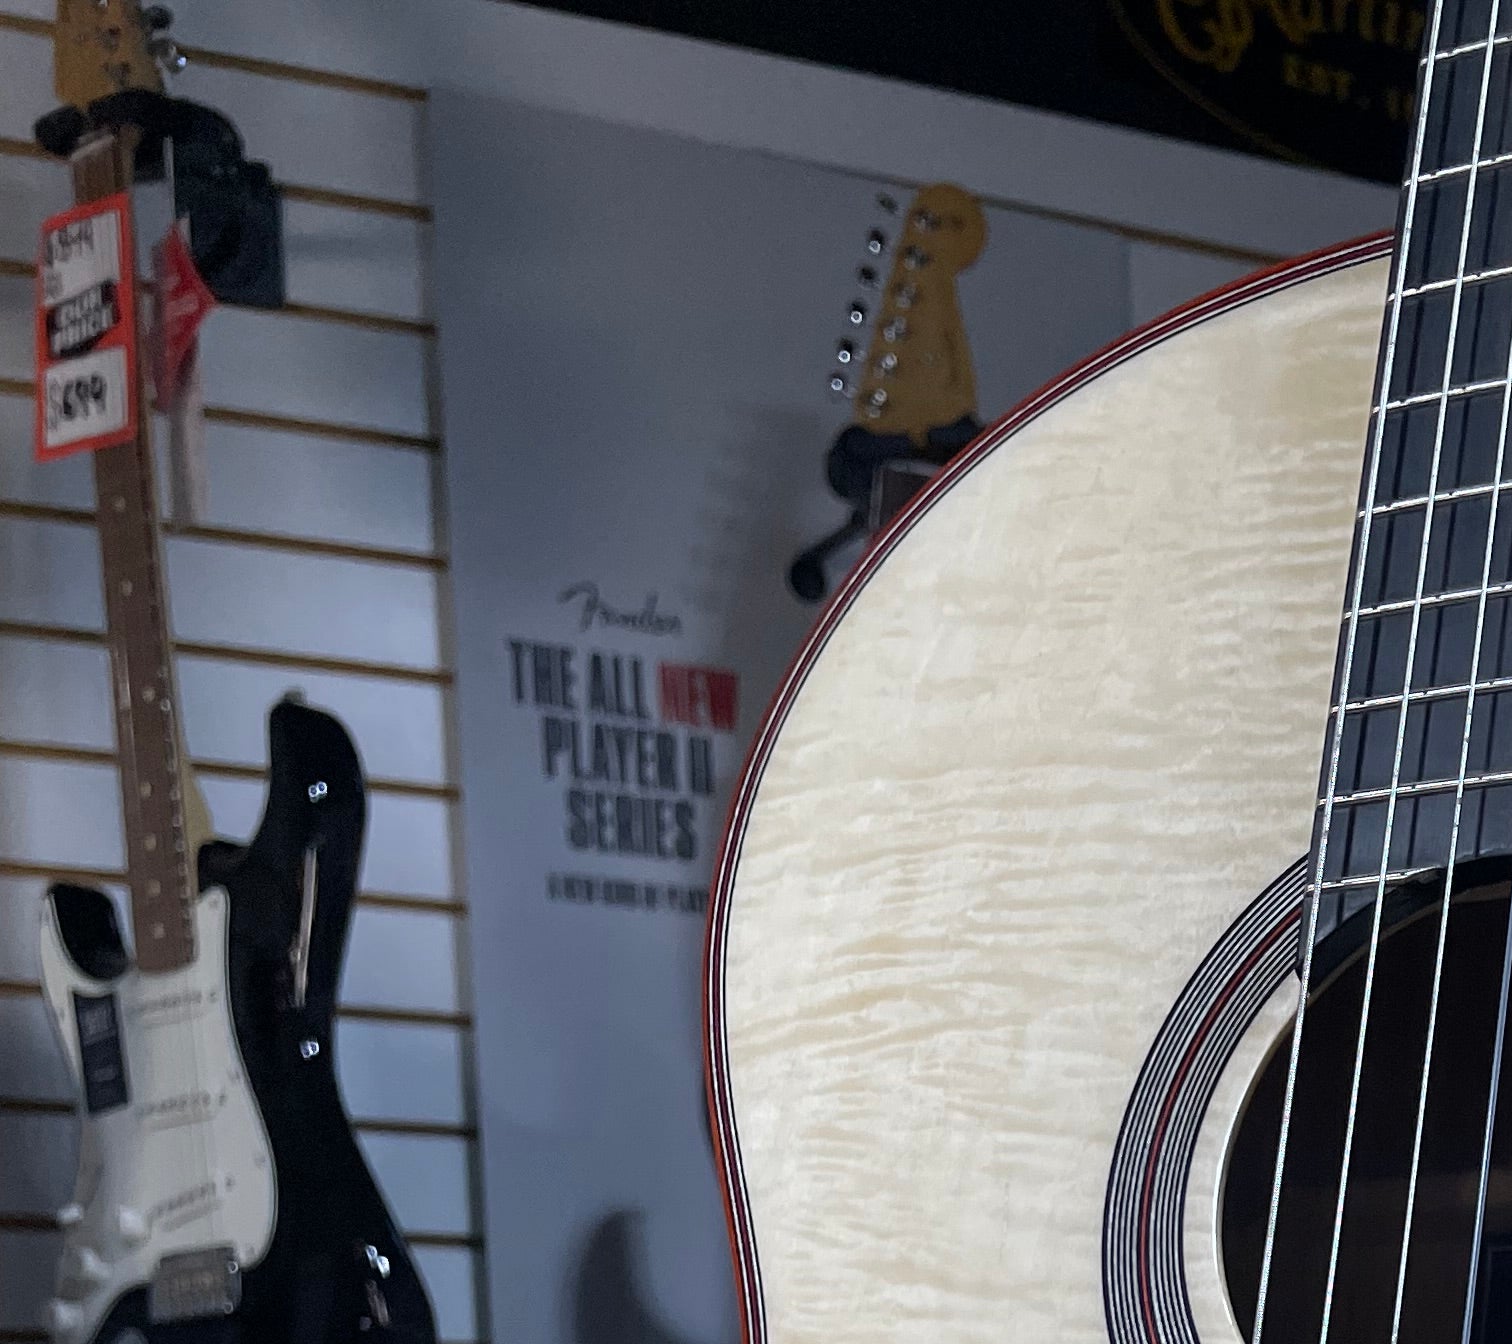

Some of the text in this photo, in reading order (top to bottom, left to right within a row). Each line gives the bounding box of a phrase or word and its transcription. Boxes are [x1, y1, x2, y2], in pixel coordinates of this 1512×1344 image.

[505, 637, 740, 732] THE ALL NEW
[542, 716, 678, 792] PLAYER
[564, 790, 696, 861] SERIES
